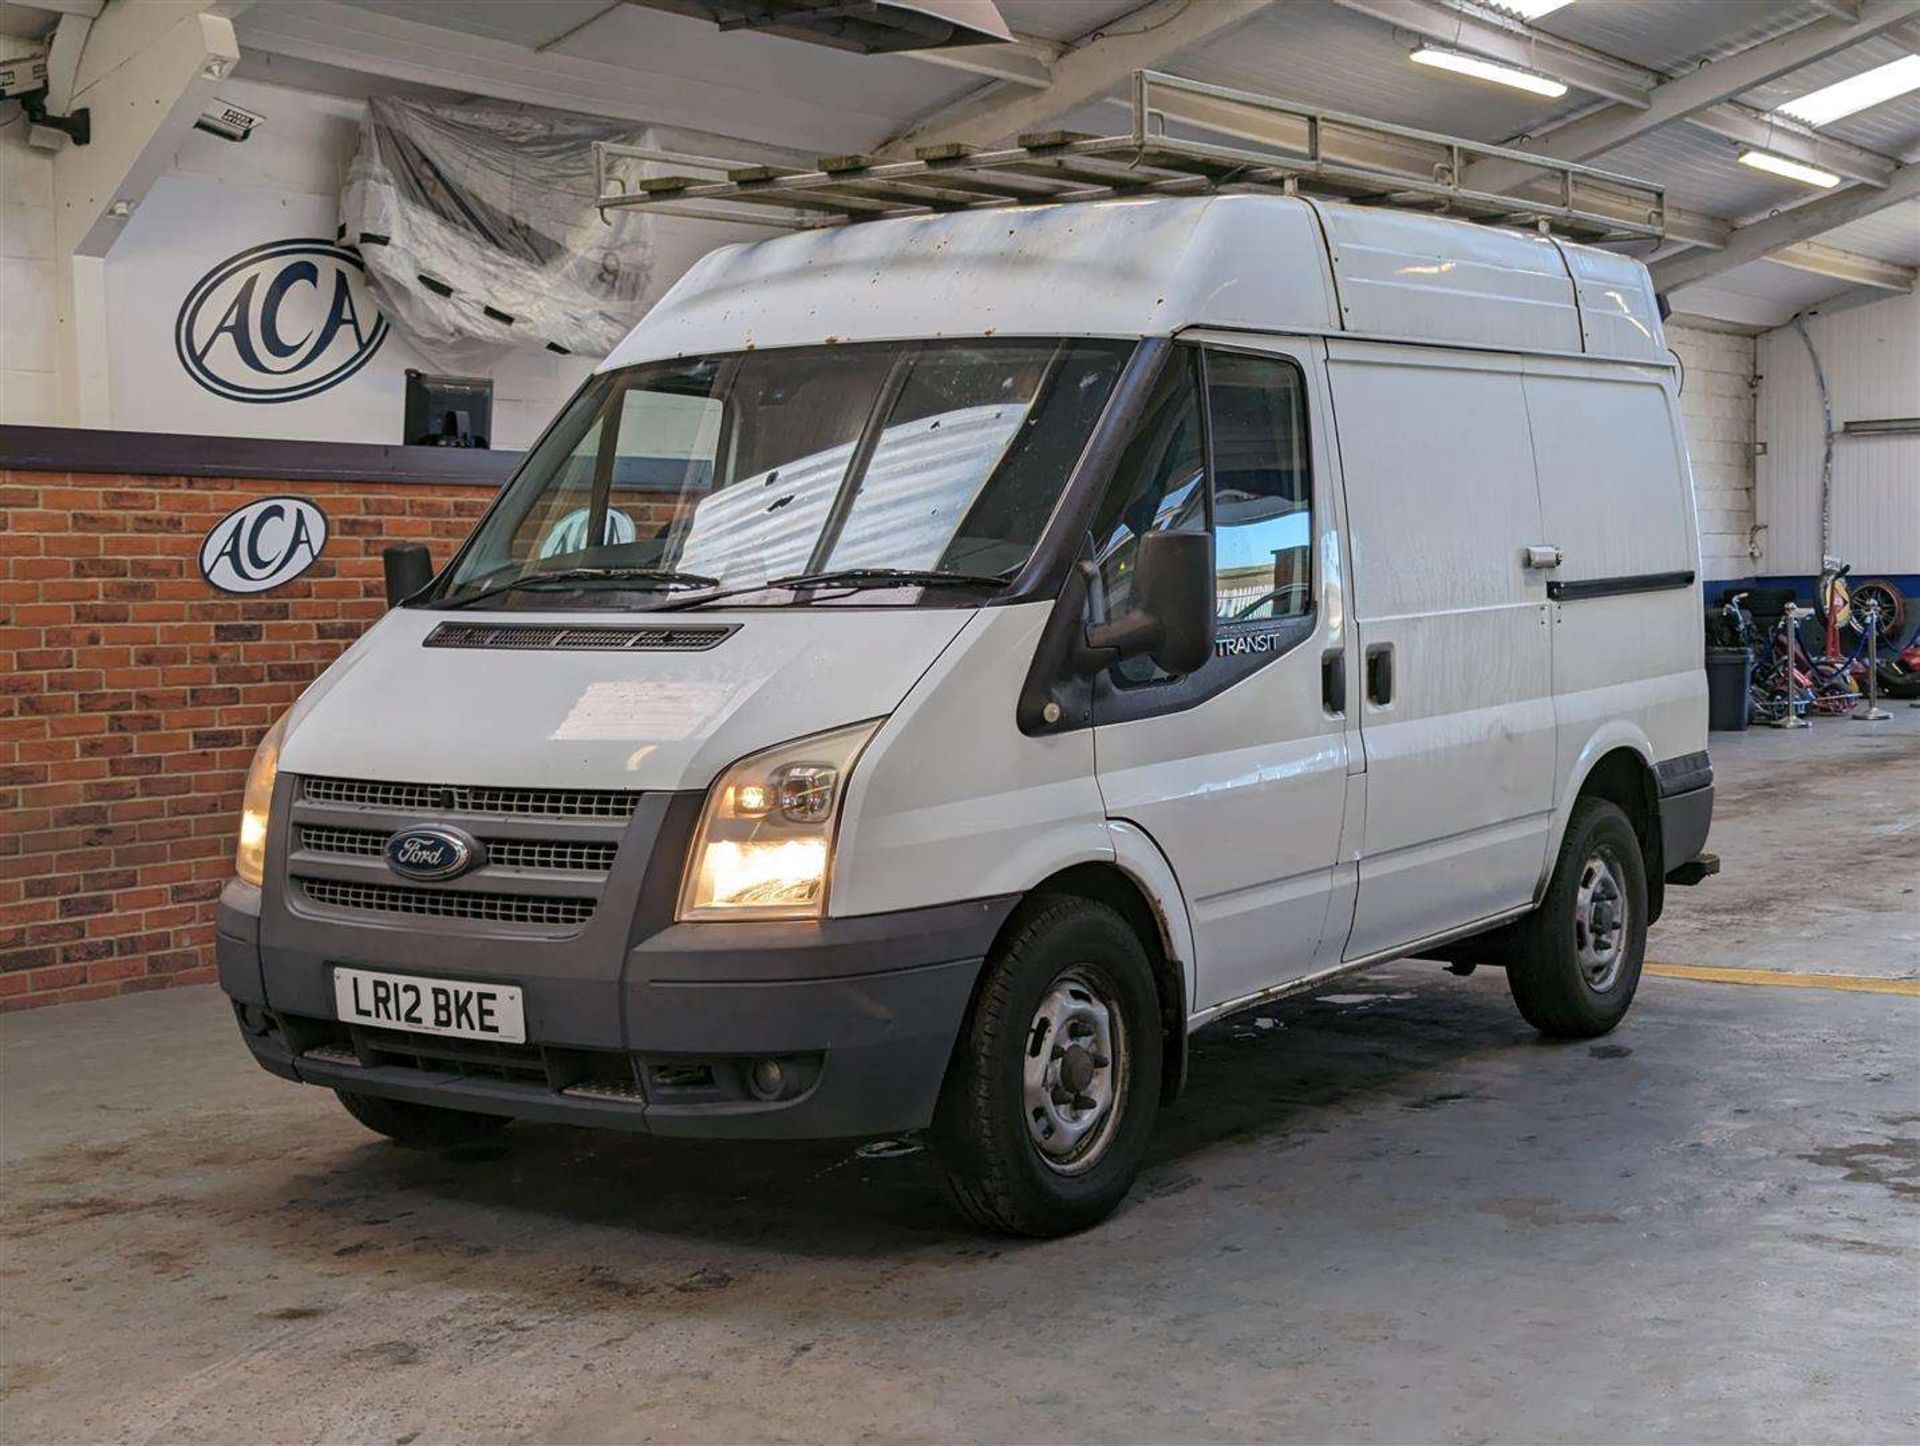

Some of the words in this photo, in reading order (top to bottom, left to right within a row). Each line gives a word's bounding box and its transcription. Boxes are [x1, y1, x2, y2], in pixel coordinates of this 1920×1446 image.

[198, 260, 366, 375] ACA
[205, 504, 314, 581] ACA
[1215, 633, 1280, 657] TRANSIT
[397, 837, 445, 865] Ford
[353, 977, 423, 1025] LR12
[431, 987, 499, 1033] BKE
